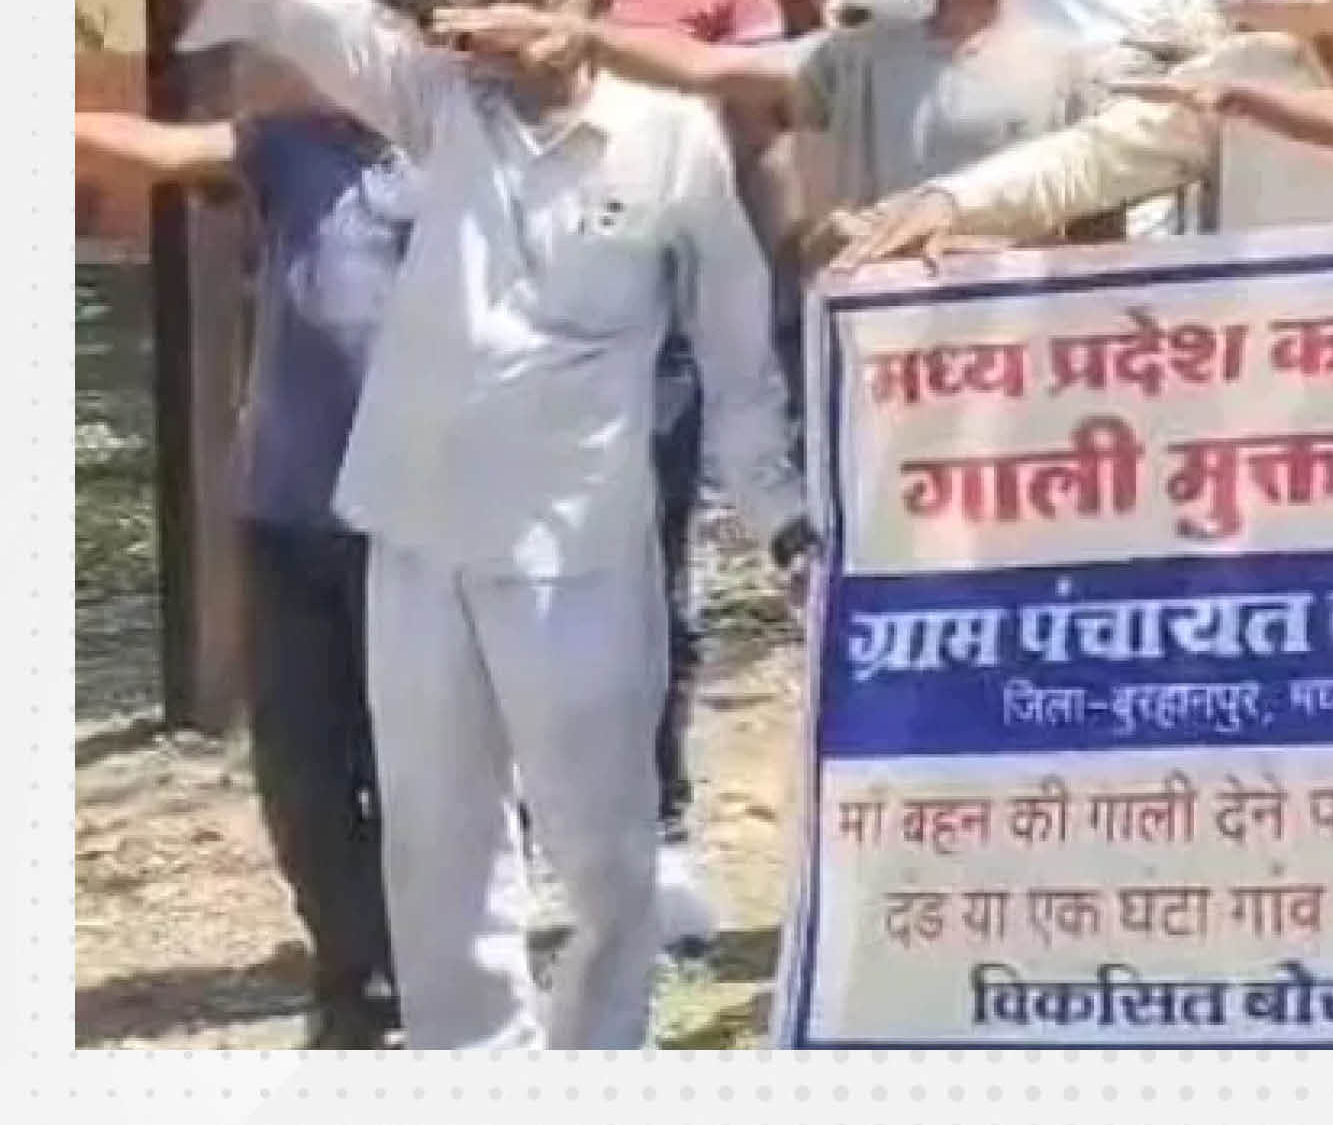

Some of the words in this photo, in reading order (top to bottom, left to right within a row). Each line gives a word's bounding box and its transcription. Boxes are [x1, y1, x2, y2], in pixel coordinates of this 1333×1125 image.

[1045, 305, 1249, 397] प्रदेश
[900, 416, 1144, 522] गाली
[848, 608, 1003, 681] ग्राम
[1019, 577, 1313, 656] पंचायत
[902, 794, 992, 855] बहन
[1008, 774, 1068, 843] की
[1088, 768, 1198, 843] गाली
[1215, 774, 1288, 841] देने
[962, 891, 1010, 942] या
[1027, 889, 1102, 950] एक
[1229, 861, 1325, 938] गांव
[969, 962, 1226, 1025] विकसित
